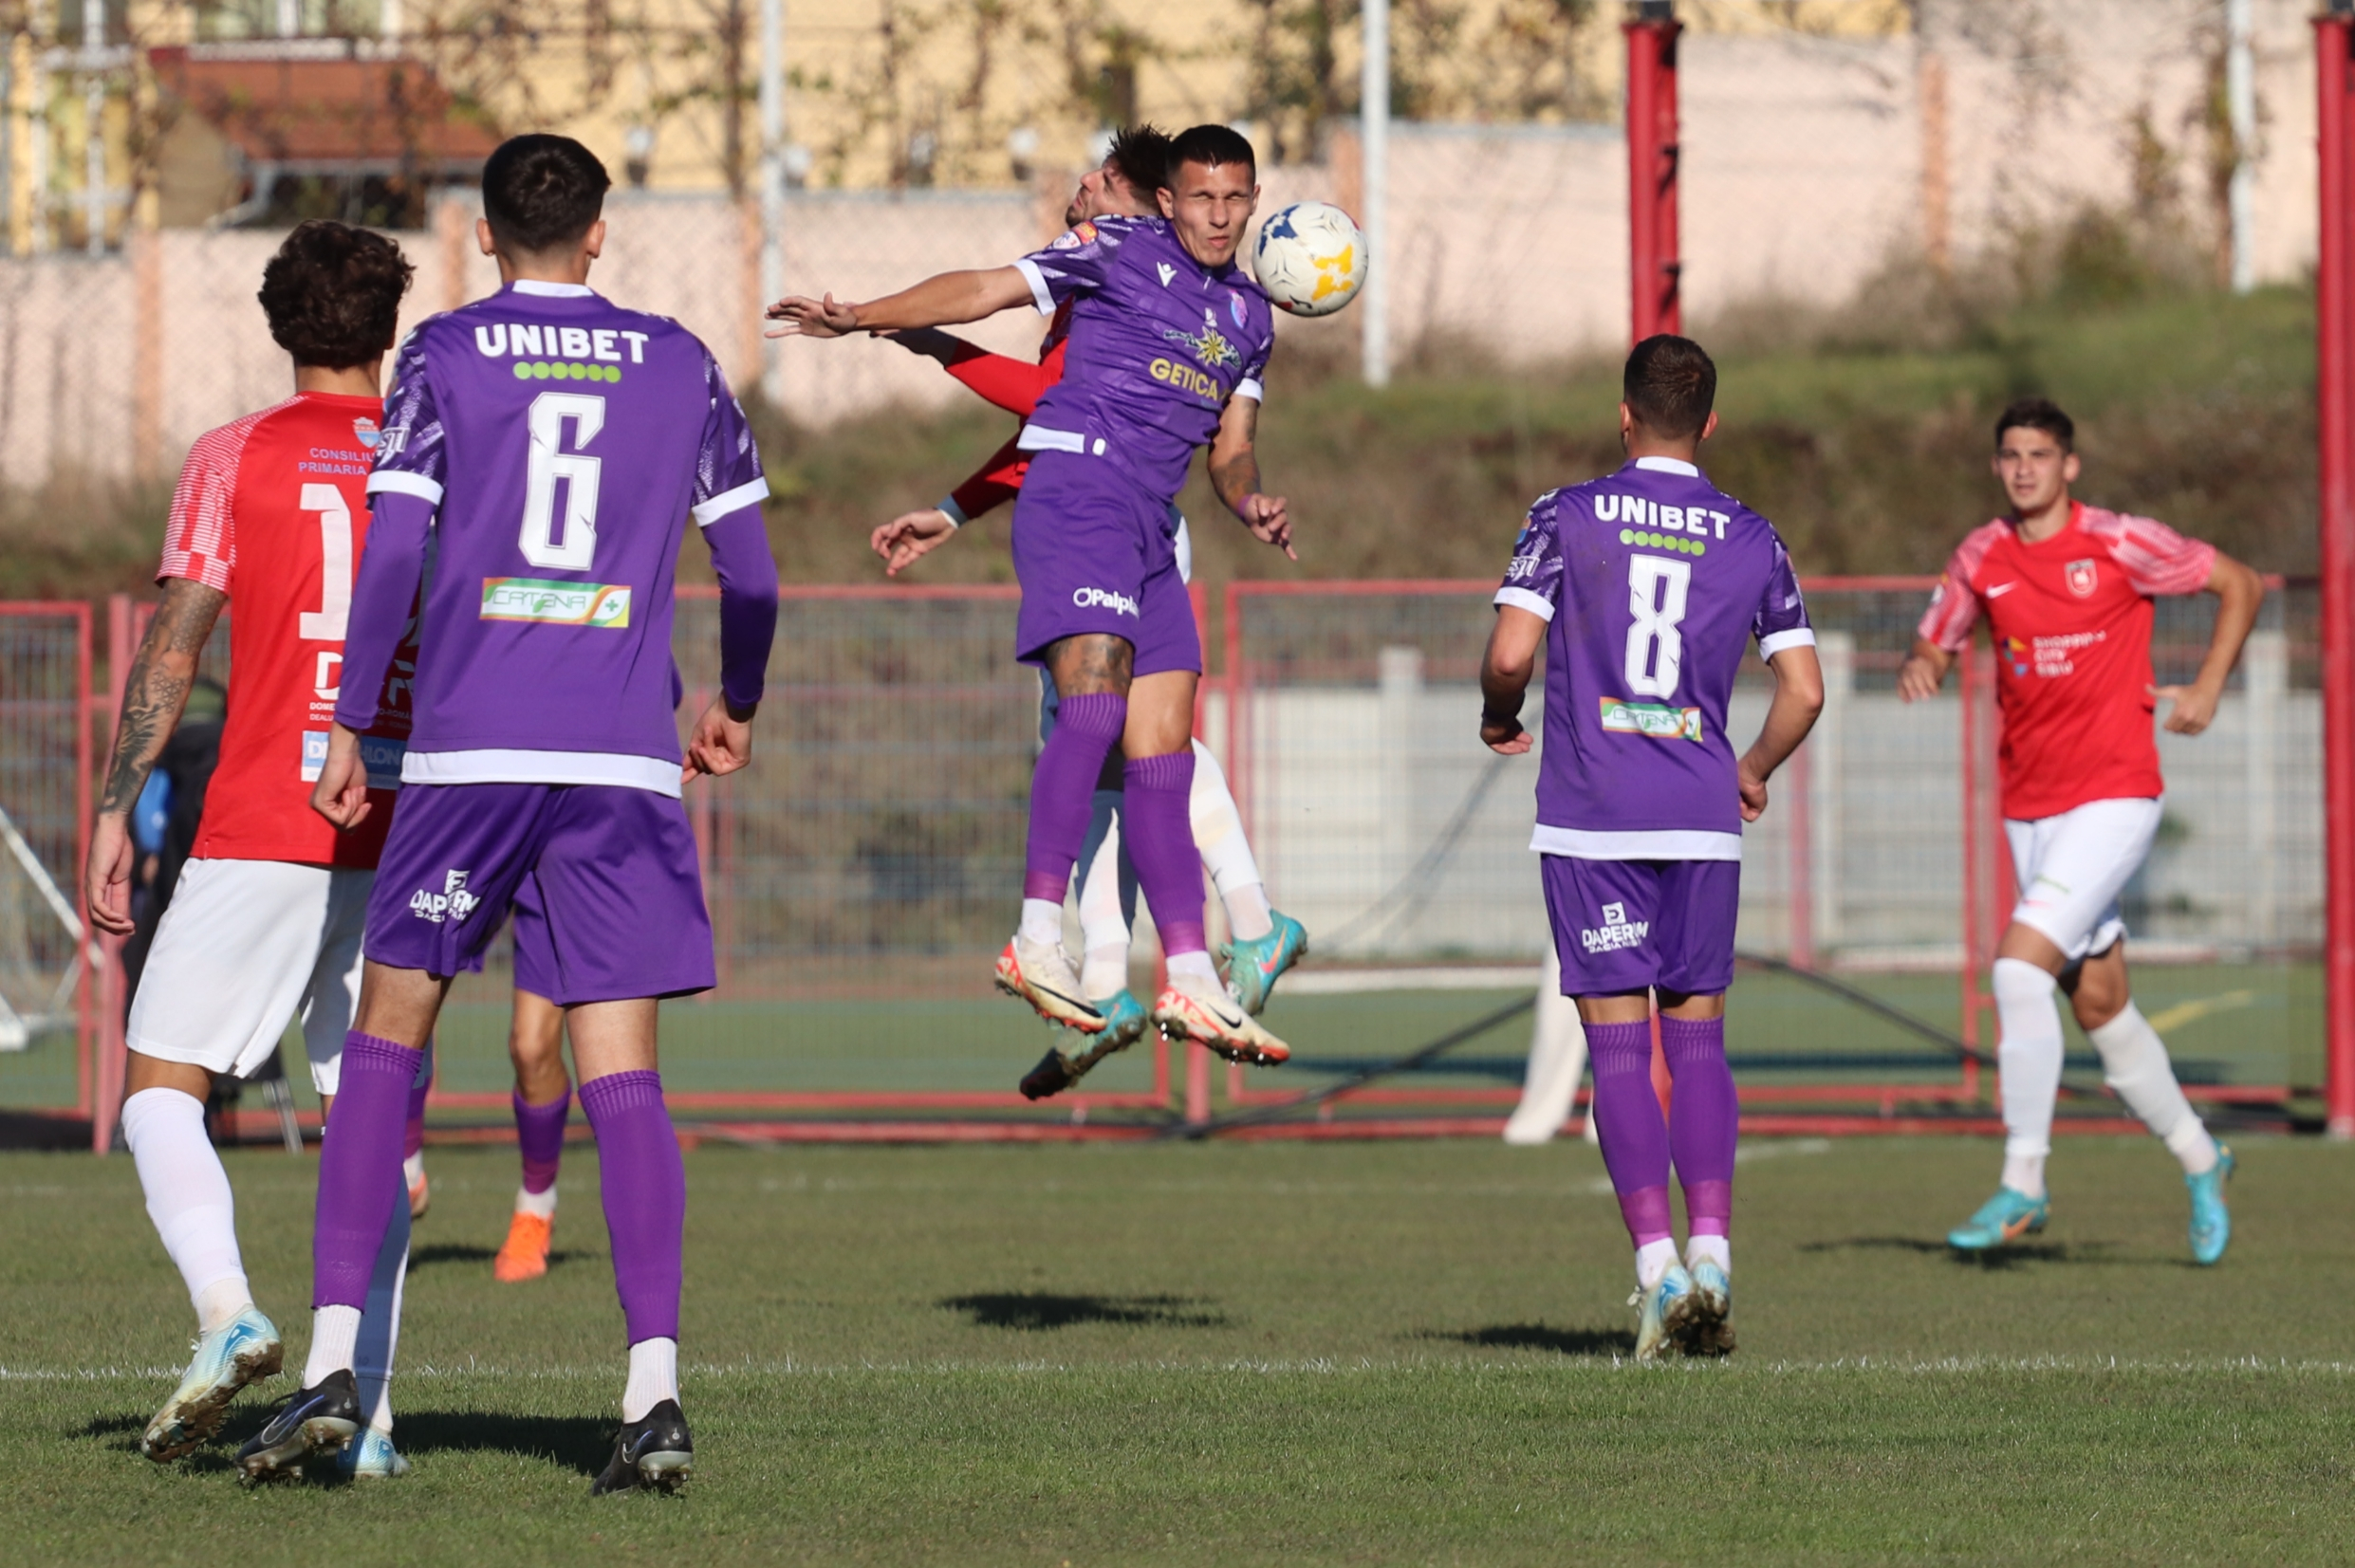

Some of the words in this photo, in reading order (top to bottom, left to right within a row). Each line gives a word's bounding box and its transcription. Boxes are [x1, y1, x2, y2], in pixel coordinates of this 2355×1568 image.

[474, 323, 649, 363] UNIBET
[1150, 358, 1218, 401] GETICA
[298, 462, 367, 475] PRIMARIA
[309, 448, 375, 462] CONSILIU
[518, 391, 605, 571] 6
[1594, 494, 1731, 540] UNIBET
[299, 483, 352, 641] 1
[492, 590, 586, 609] CATENA
[1624, 553, 1692, 700] 8
[309, 702, 335, 711] DOME
[309, 713, 334, 722] DEALU
[1614, 709, 1678, 727] CATENA
